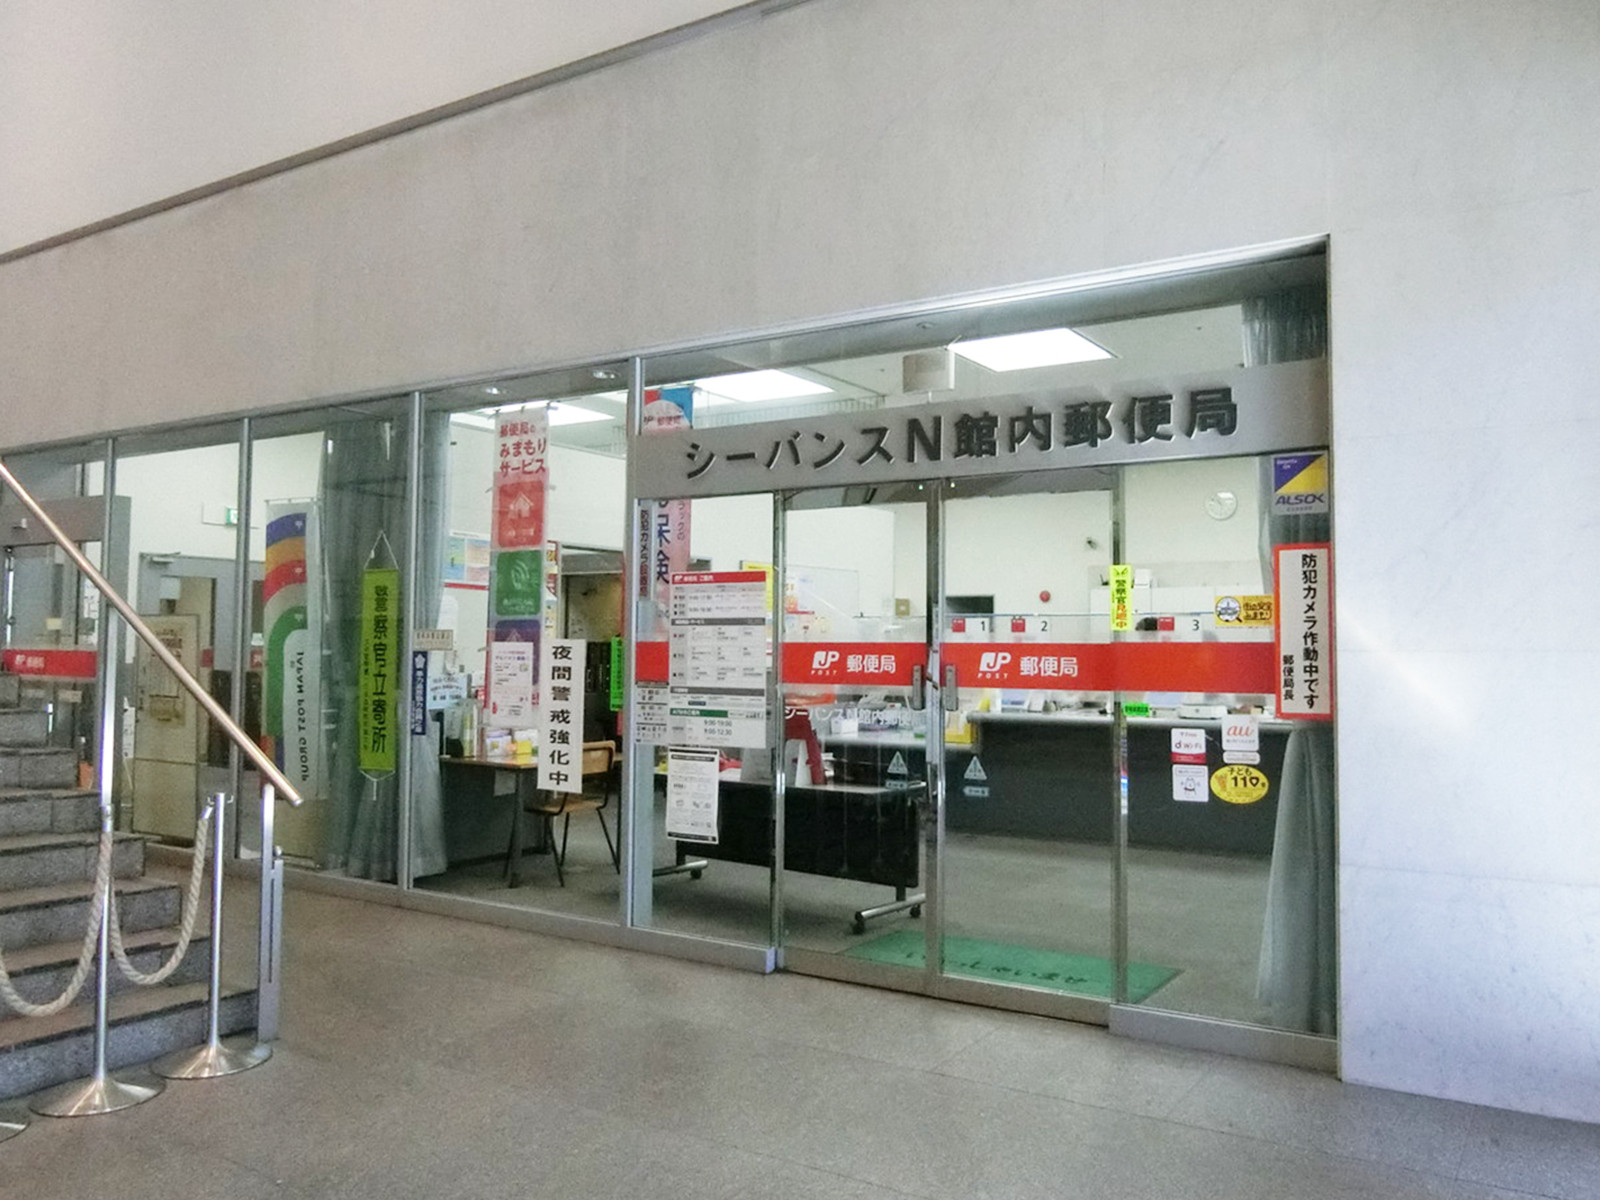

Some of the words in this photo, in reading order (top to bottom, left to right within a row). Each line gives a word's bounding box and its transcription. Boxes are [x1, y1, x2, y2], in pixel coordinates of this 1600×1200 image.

[499, 423, 536, 438] 郵便局の
[684, 386, 1238, 479] シーバンスN館内郵便局
[499, 437, 547, 458] みまもり
[499, 458, 546, 477] サービス
[1275, 493, 1324, 506] ALSOK
[980, 621, 986, 631] 1
[1041, 621, 1048, 631] 2
[1192, 619, 1199, 631] 3
[1301, 553, 1319, 709] 防犯カメラ作動中です
[372, 585, 389, 753] 警察官立寄所
[846, 653, 897, 674] 郵便局
[1020, 656, 1078, 677] 郵便局
[1282, 655, 1295, 701] 郵便局長
[549, 645, 573, 785] 夜間警戒強化中
[1227, 725, 1251, 737] au
[1227, 767, 1252, 776] 子ども
